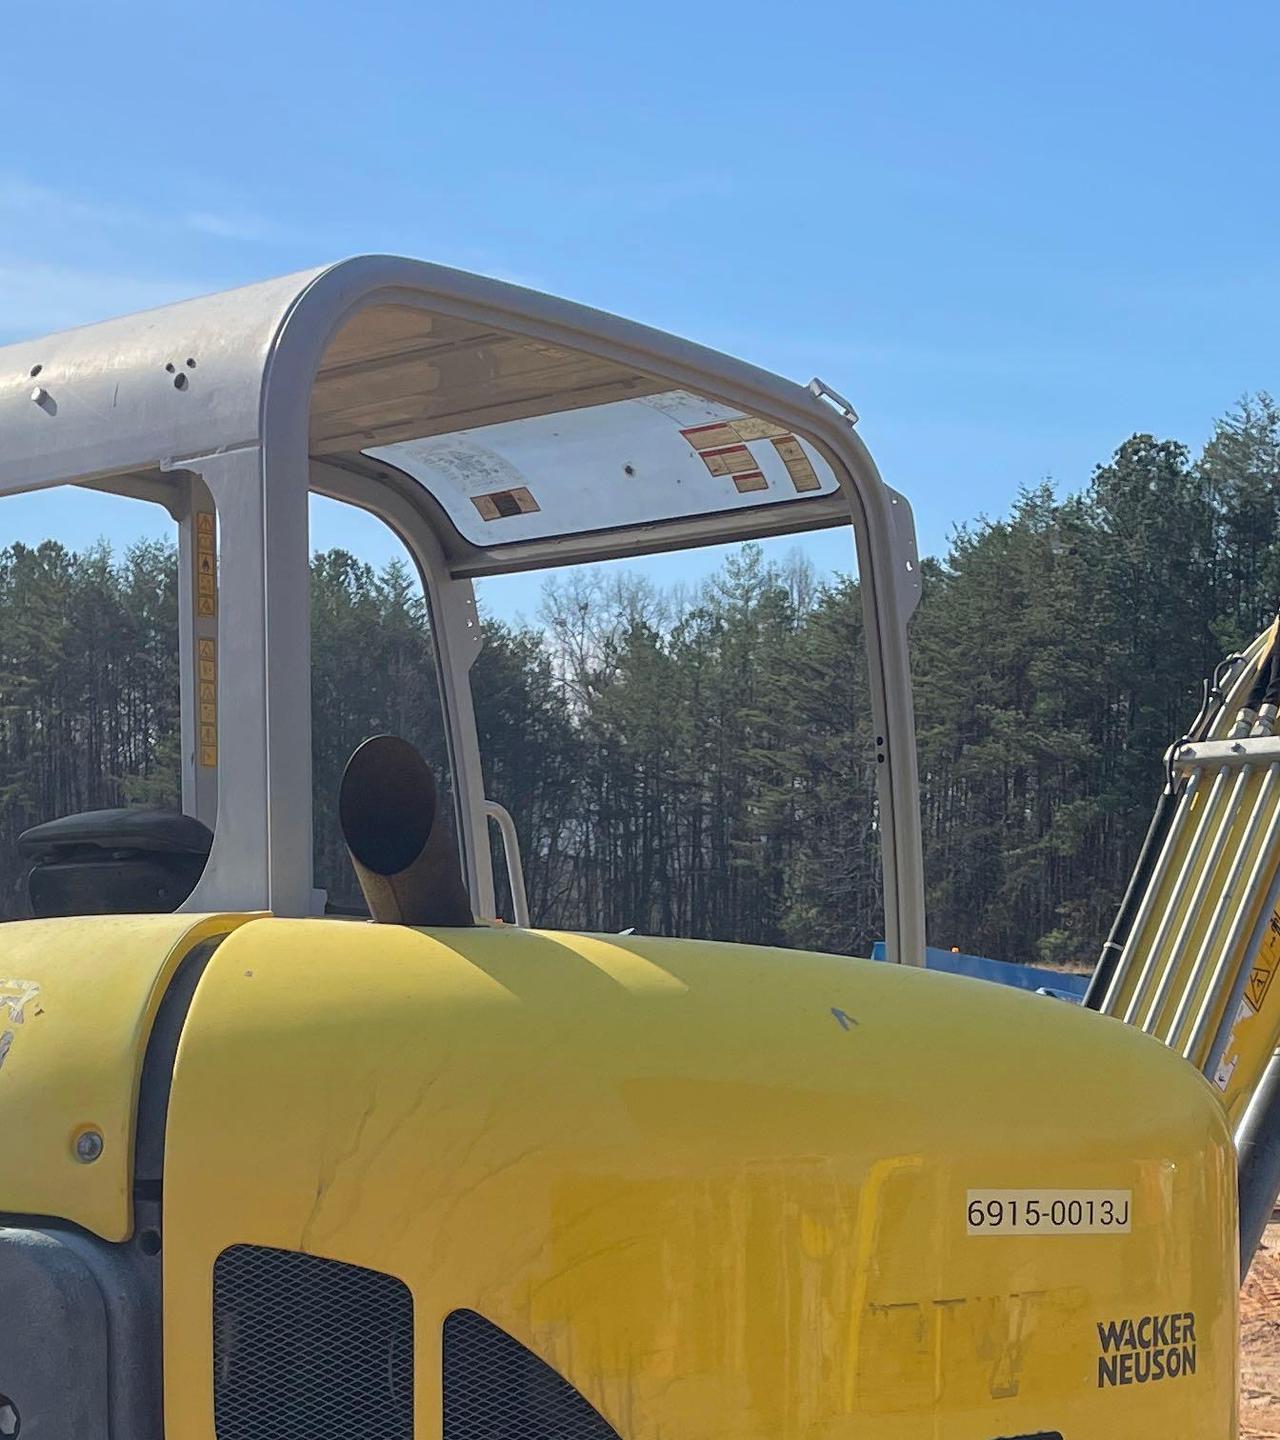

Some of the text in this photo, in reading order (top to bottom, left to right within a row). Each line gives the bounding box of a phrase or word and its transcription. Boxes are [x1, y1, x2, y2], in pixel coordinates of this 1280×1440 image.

[967, 1199, 1129, 1227] 6915-0013J
[1096, 1312, 1197, 1353] WACKER
[1097, 1344, 1197, 1388] NEUSON
